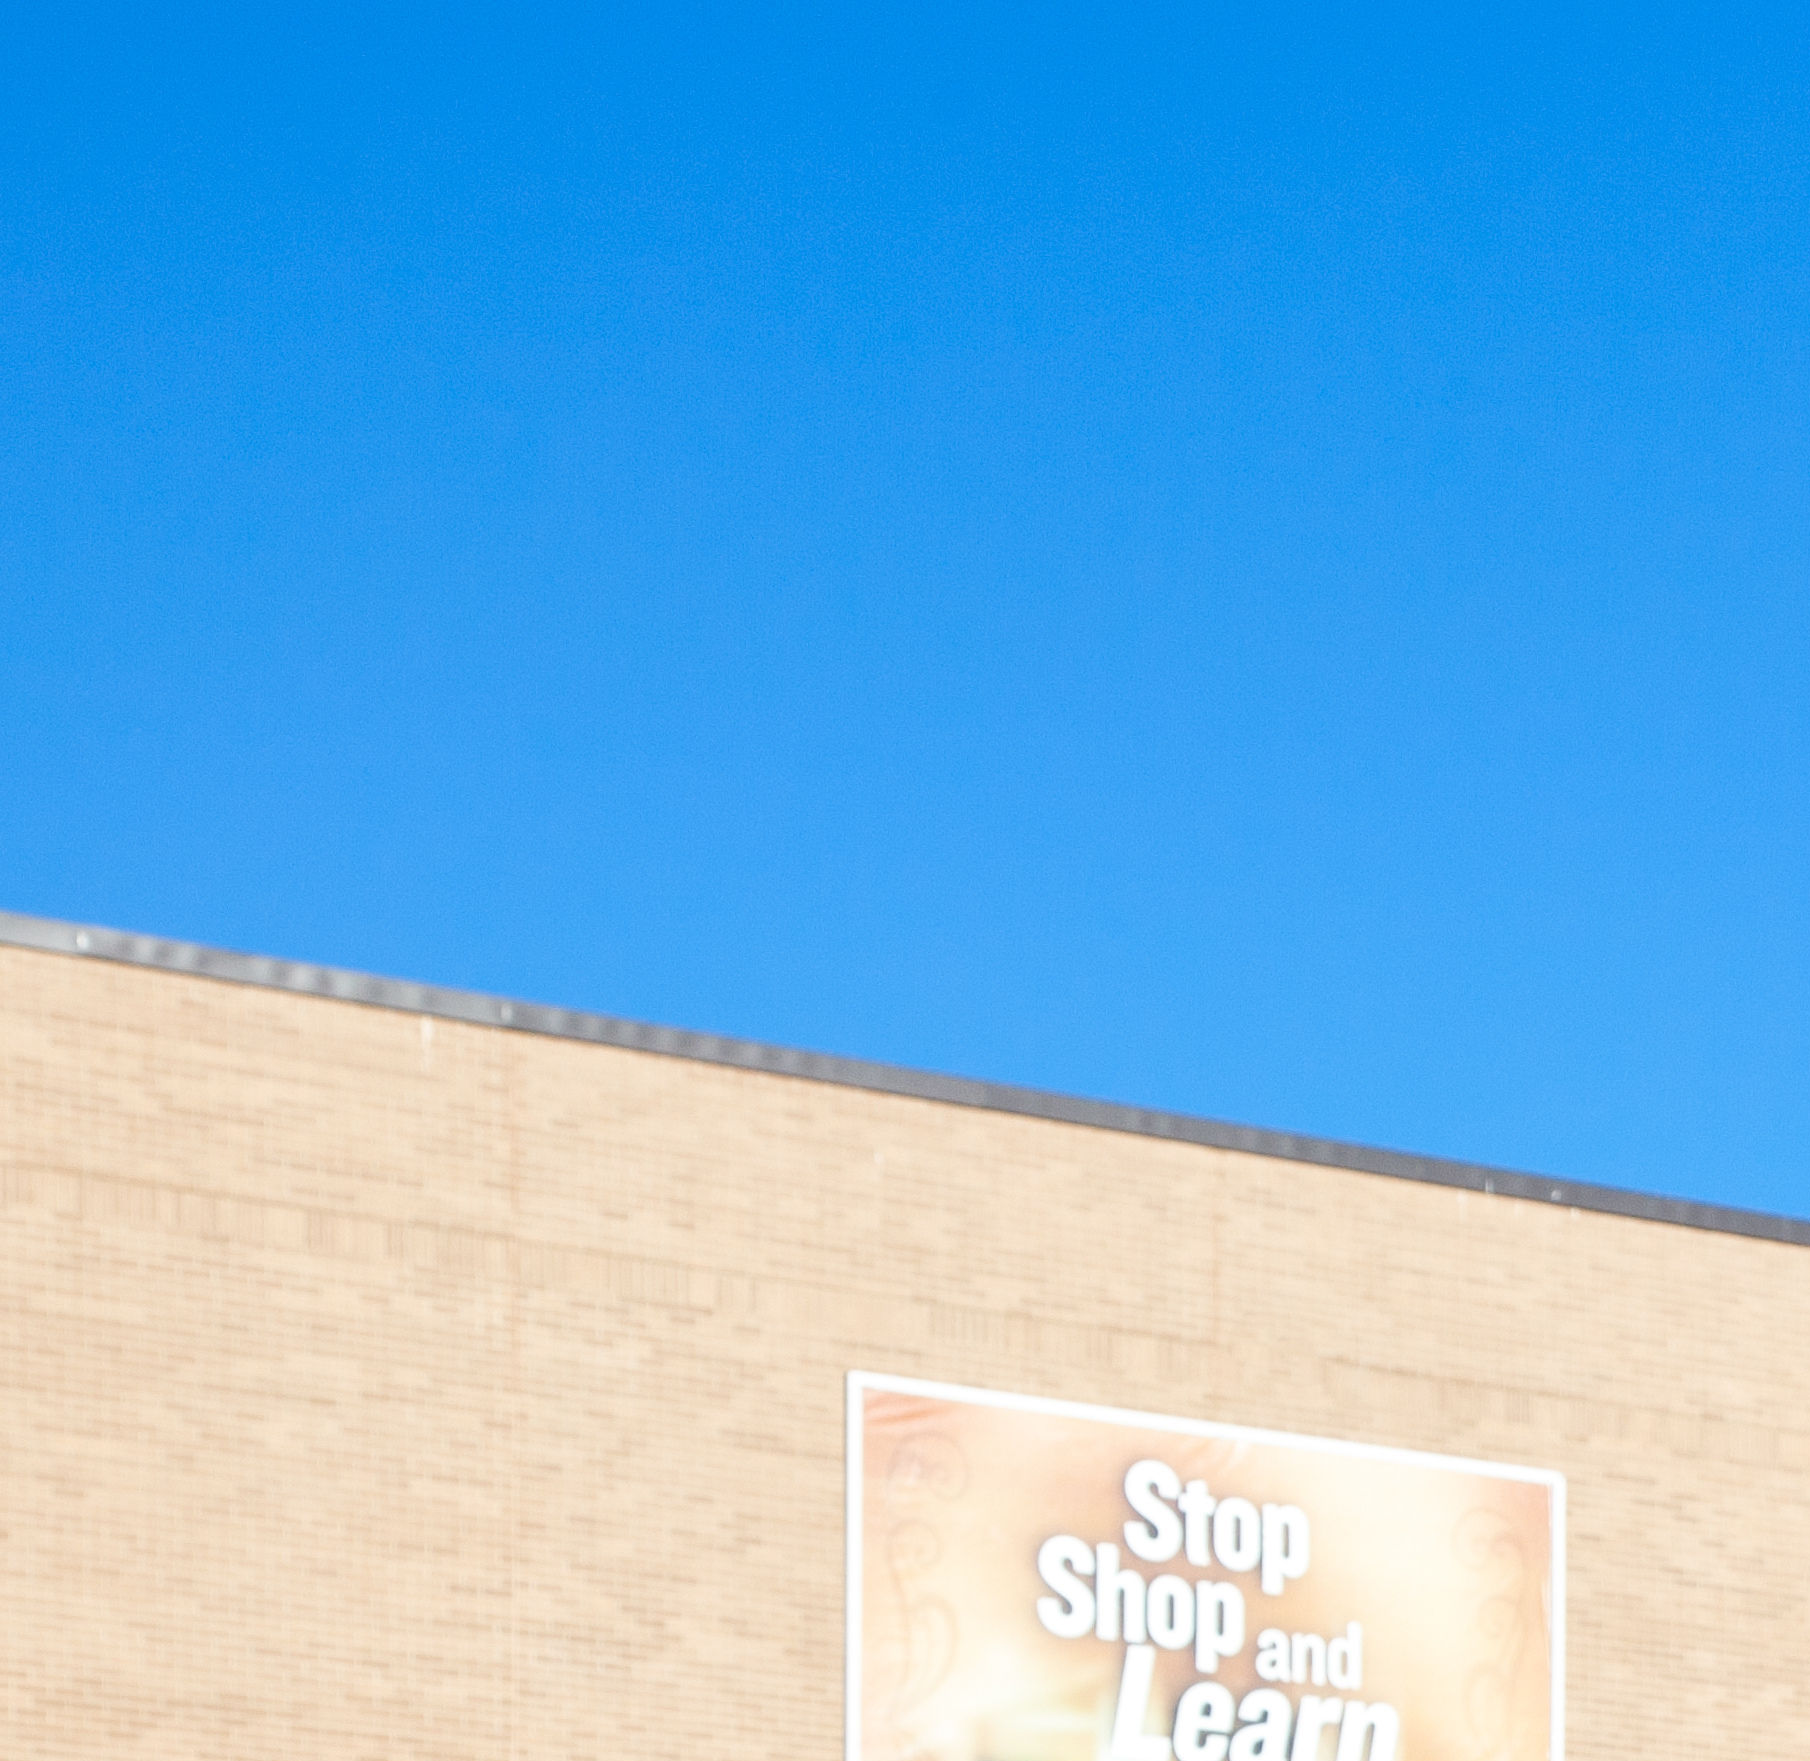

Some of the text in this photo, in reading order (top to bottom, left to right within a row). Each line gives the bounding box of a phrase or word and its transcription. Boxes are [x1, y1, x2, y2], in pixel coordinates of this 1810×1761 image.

[1123, 1460, 1309, 1596] Stop
[1036, 1534, 1363, 1690] Shop and
